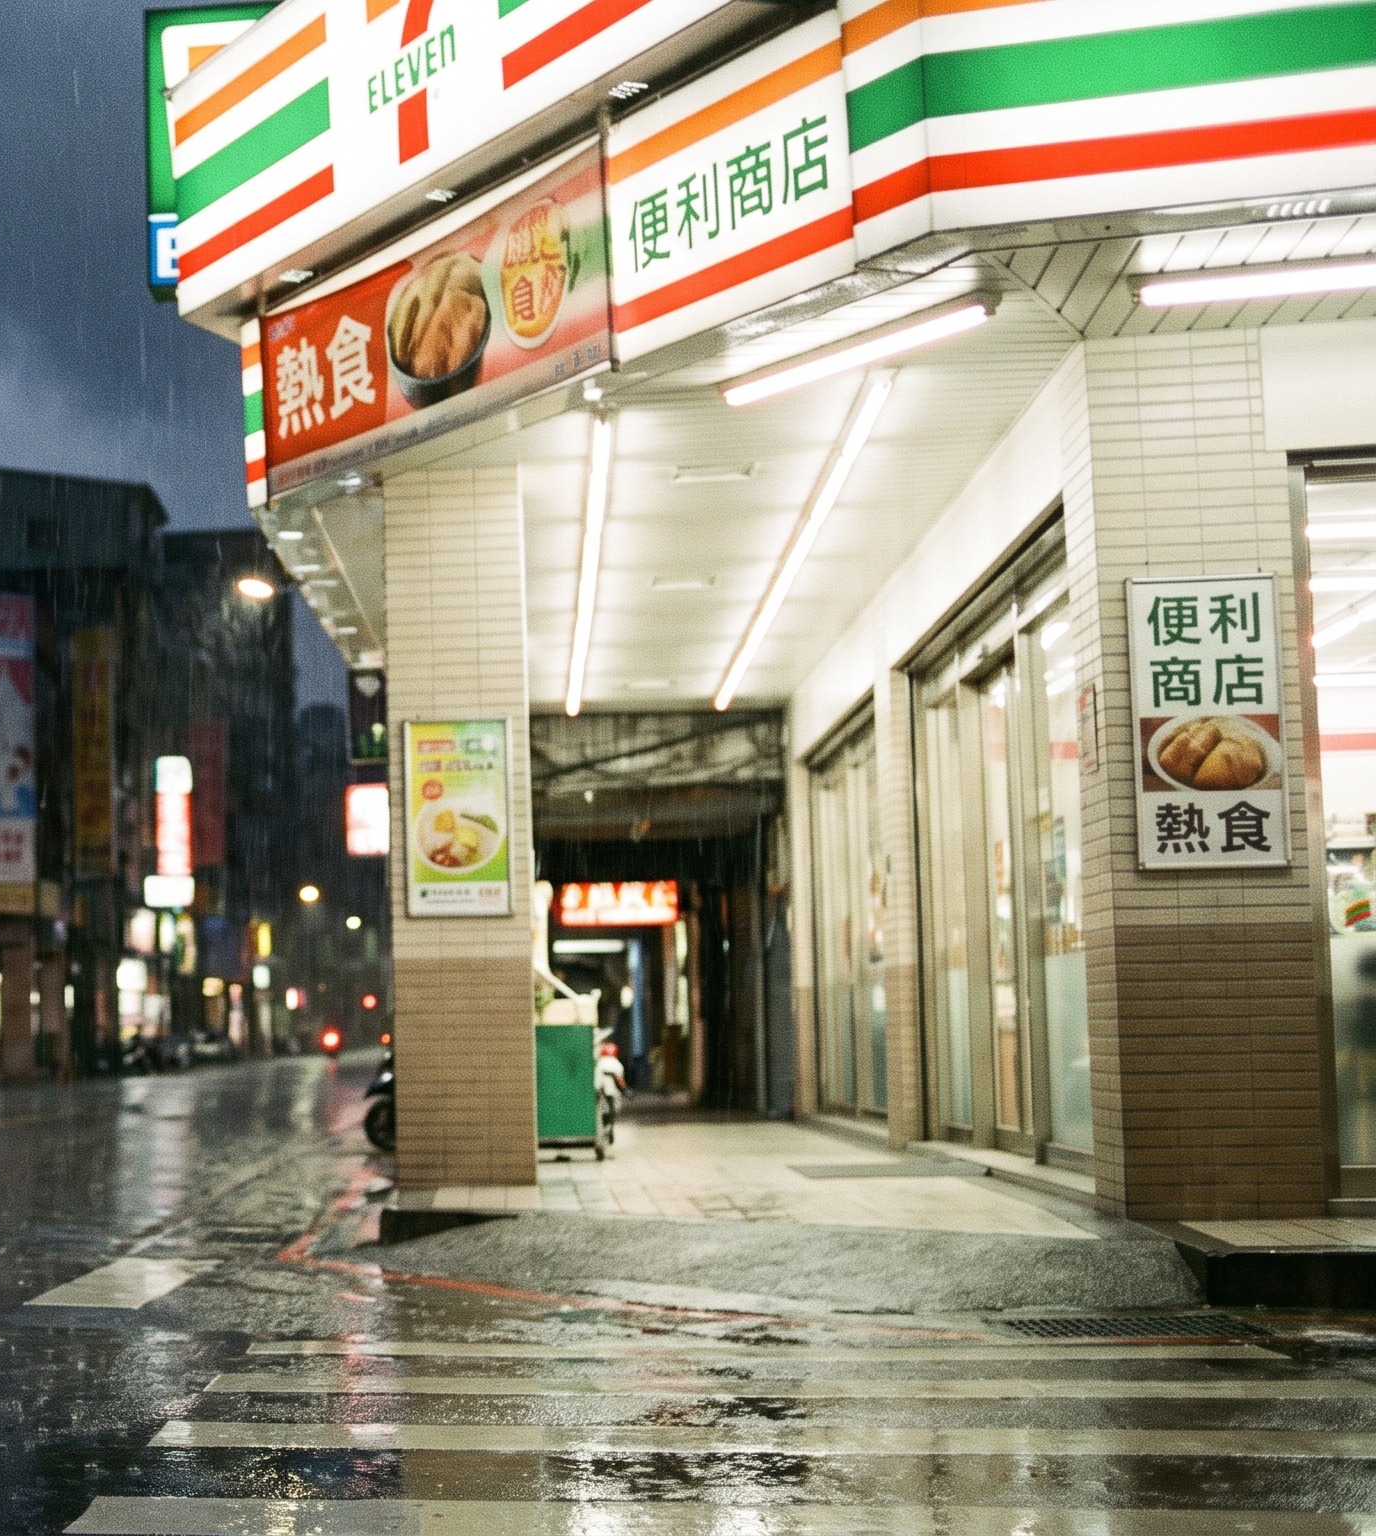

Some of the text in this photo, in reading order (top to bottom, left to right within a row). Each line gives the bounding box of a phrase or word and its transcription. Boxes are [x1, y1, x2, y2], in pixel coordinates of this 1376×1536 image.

[629, 114, 829, 274] 便利商店
[275, 314, 377, 440] 熱食
[1147, 592, 1261, 646] 便利
[1150, 654, 1265, 708] 商店
[1156, 801, 1272, 855] 熱食
